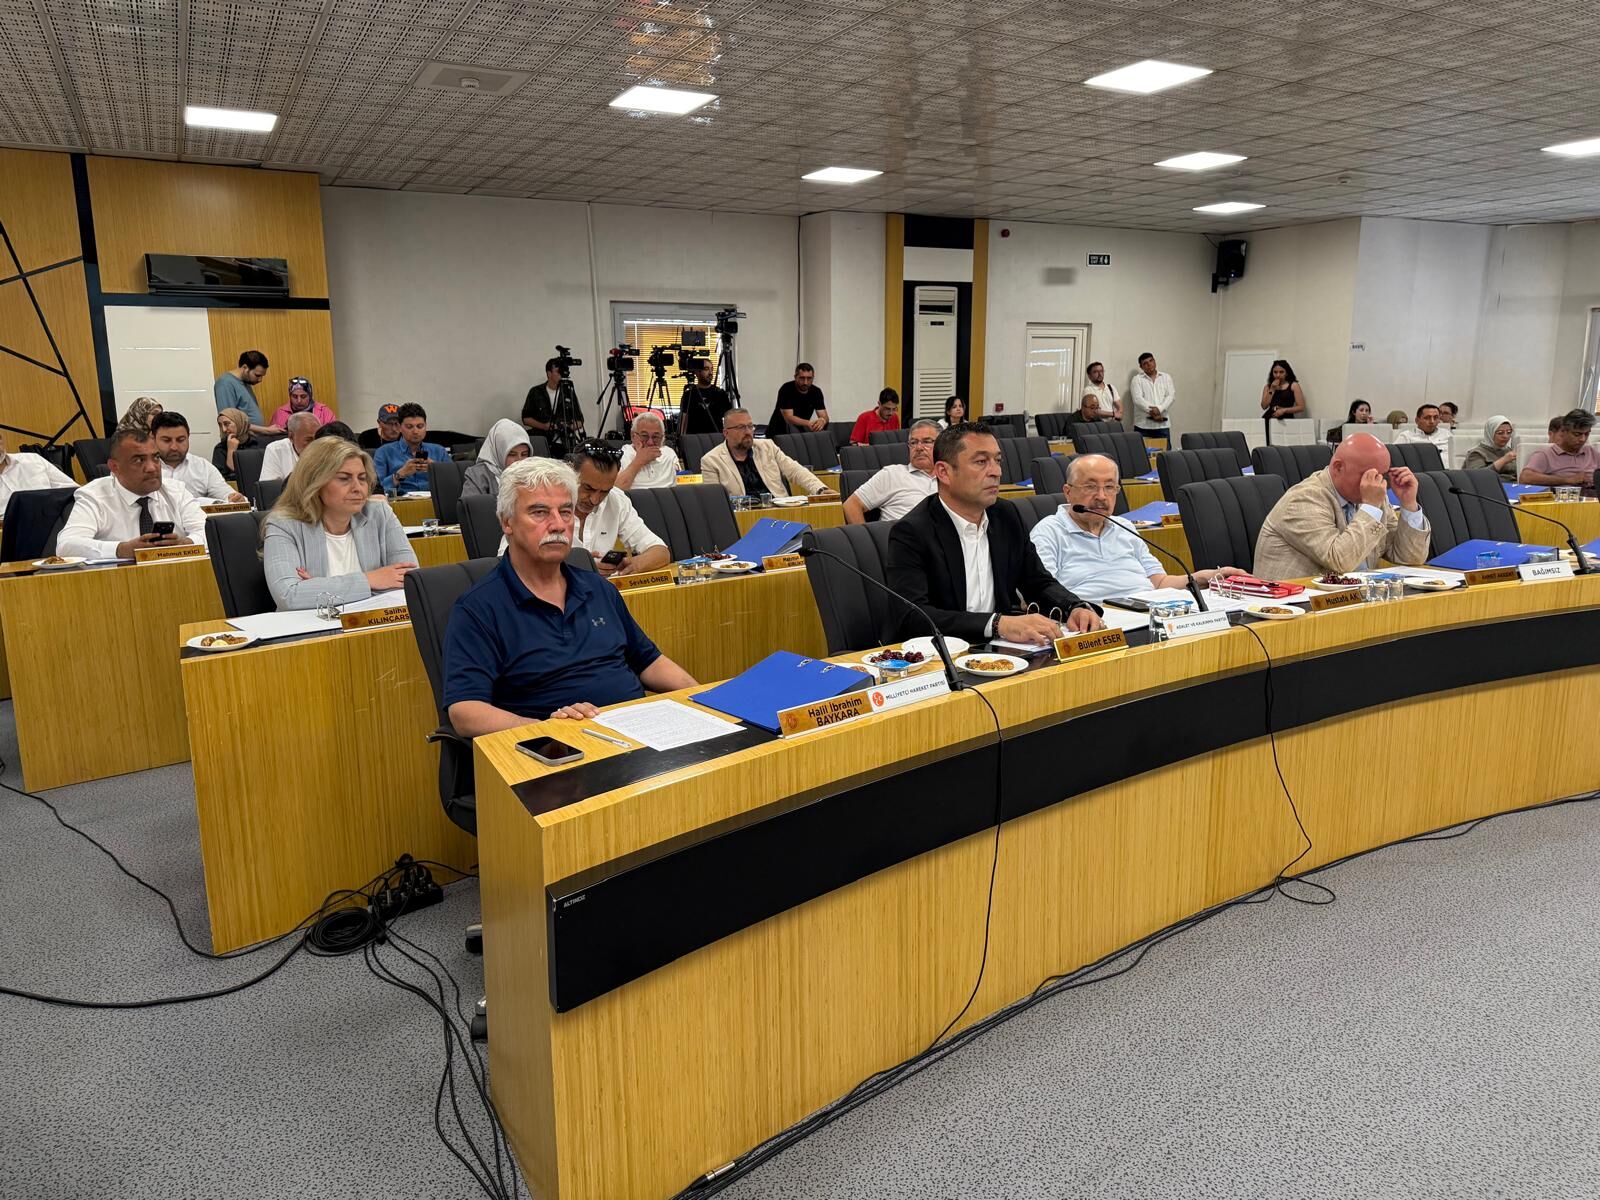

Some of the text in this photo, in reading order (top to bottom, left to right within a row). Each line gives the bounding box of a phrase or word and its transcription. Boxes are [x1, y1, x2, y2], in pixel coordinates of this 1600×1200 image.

[1532, 567, 1561, 576] BAĞIMSIZ
[1325, 595, 1348, 605] Mustafa
[384, 607, 406, 615] Saliha
[1078, 633, 1122, 650] Bülent ESER
[910, 684, 929, 694] HAREKET
[808, 696, 863, 718] Halil İbrahim
[816, 708, 860, 726] BAYKARA
